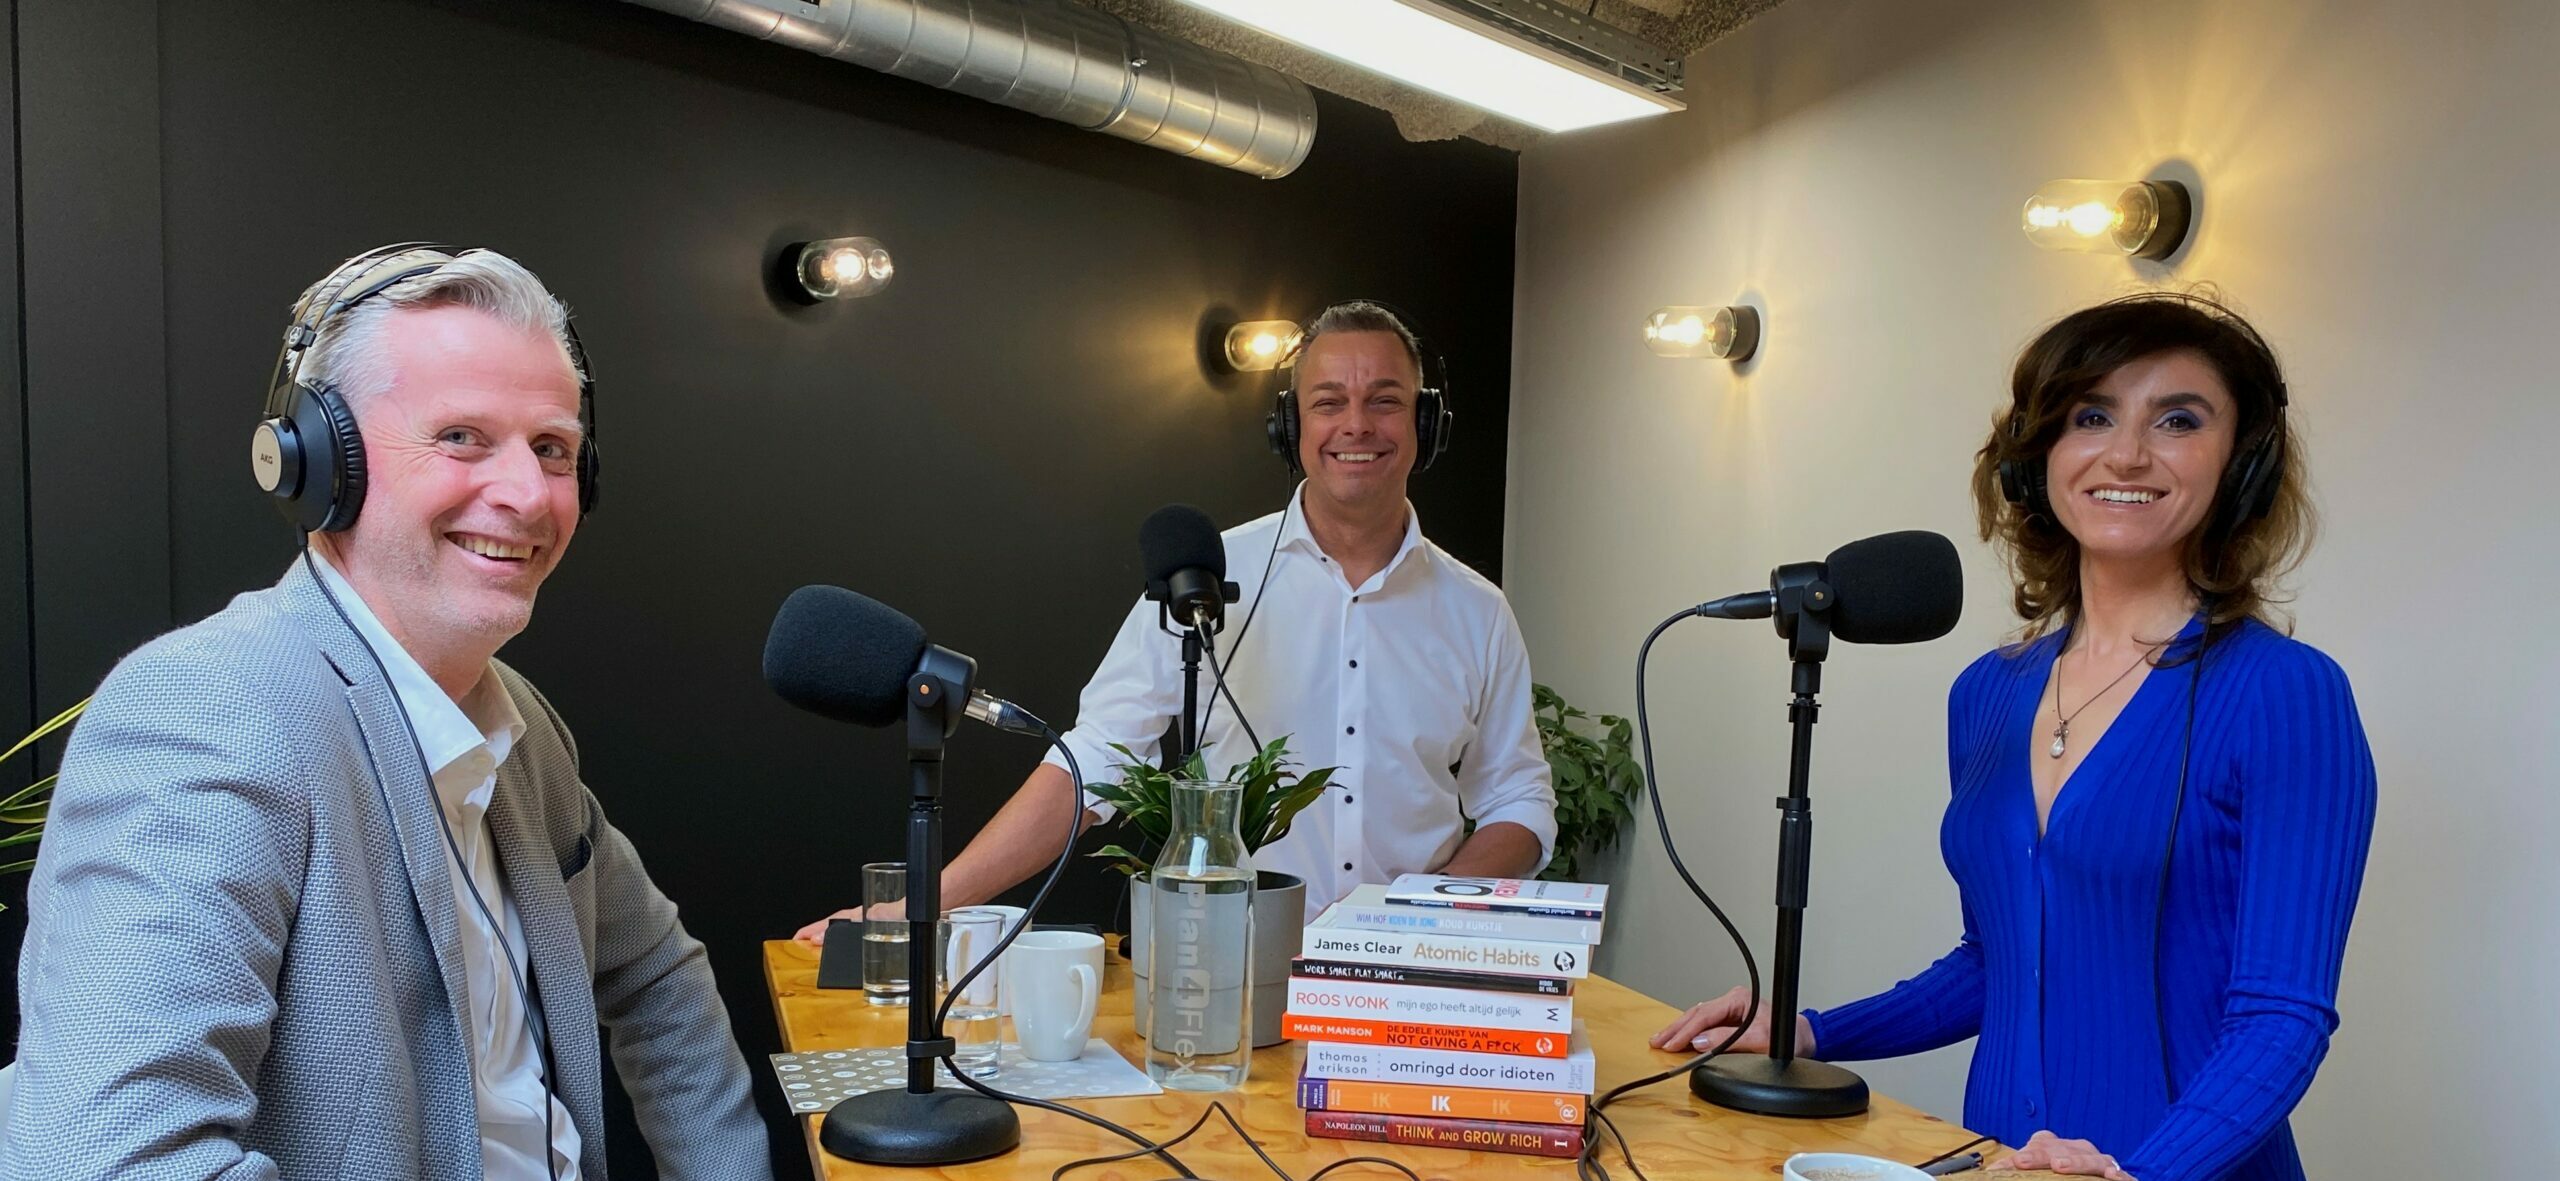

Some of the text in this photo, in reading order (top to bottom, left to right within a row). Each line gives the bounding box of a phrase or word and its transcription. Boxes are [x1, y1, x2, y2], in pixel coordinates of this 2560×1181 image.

[260, 453, 273, 465] AKG
[1356, 913, 1371, 923] WIM
[1373, 914, 1387, 924] HOF
[1440, 918, 1463, 929] KOUD
[1466, 920, 1503, 933] KUNSTJE
[1314, 938, 1541, 967] James Clear Atomic Habits
[1173, 882, 1211, 1075] Plan4Flex
[1304, 964, 1326, 974] WORK
[1329, 966, 1352, 977] SMART
[1354, 968, 1372, 979] PLAY
[1296, 992, 1522, 1018] ROOS VONK mijn ego heeft altijd gelijk
[1293, 1023, 1373, 1037] MARK MANSON
[1387, 1024, 1489, 1039] DE EDELE KUNST VAN
[1386, 1033, 1416, 1045] NOT
[1419, 1036, 1468, 1049] GIVING
[1472, 1040, 1482, 1050] A
[1319, 1051, 1368, 1063] thomas
[1318, 1063, 1368, 1074] erikson
[1389, 1060, 1555, 1082] omringd door idioten
[1371, 1092, 1512, 1115] IK IK IK
[1325, 1121, 1542, 1149] NAPOLEON HILL THINK AND GROW RICH
